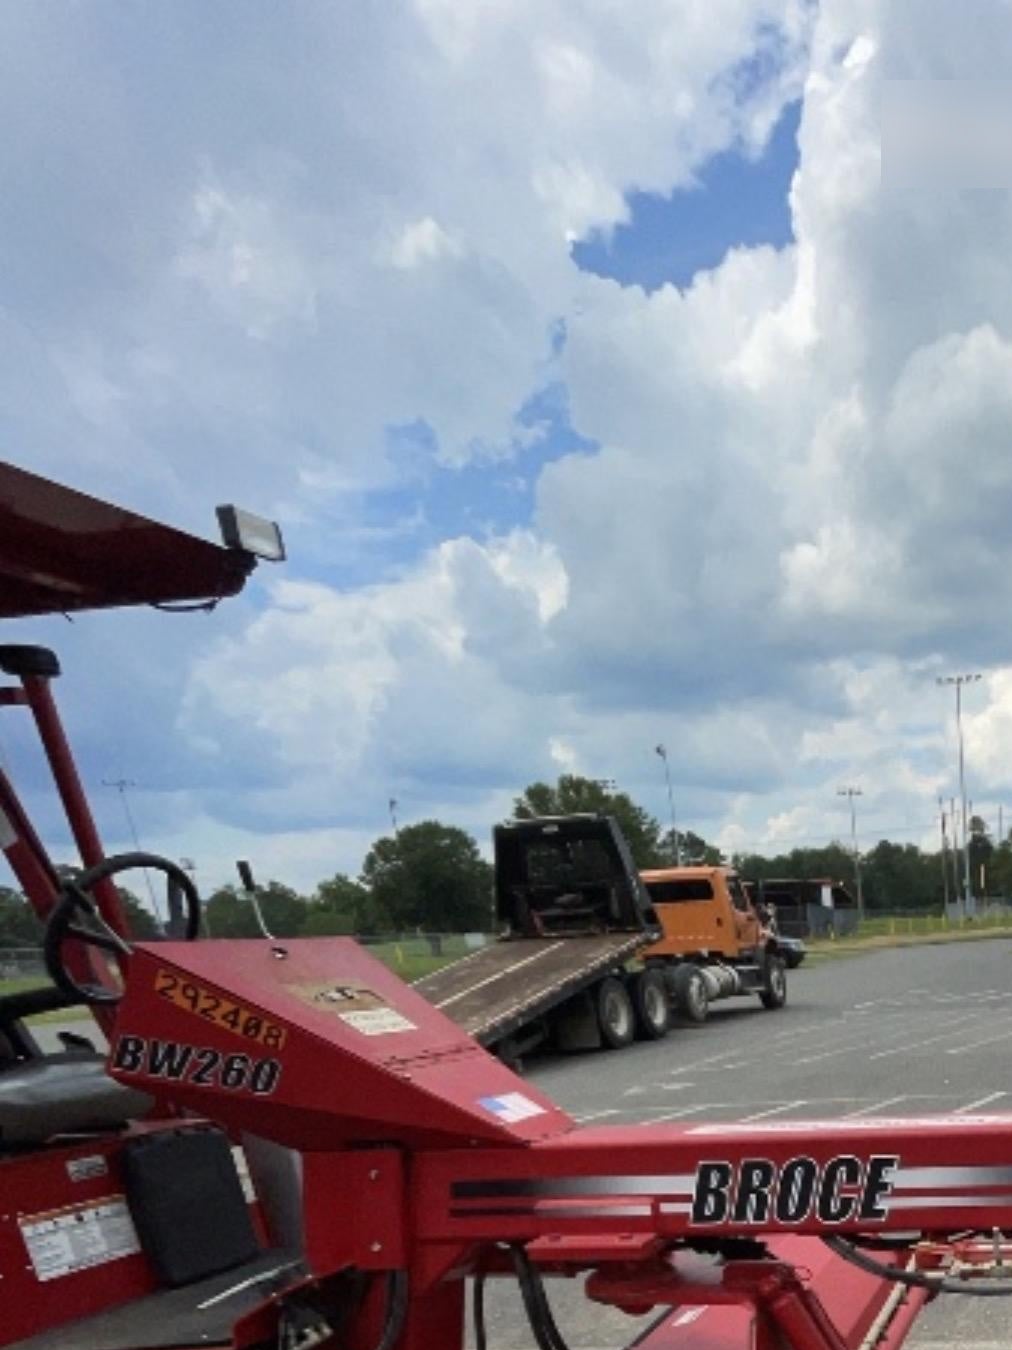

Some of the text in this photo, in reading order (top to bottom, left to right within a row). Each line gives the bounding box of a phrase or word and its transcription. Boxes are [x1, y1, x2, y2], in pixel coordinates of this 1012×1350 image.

[157, 972, 283, 1049] 292408
[111, 1035, 282, 1096] BW260
[689, 1154, 900, 1227] BROCE
